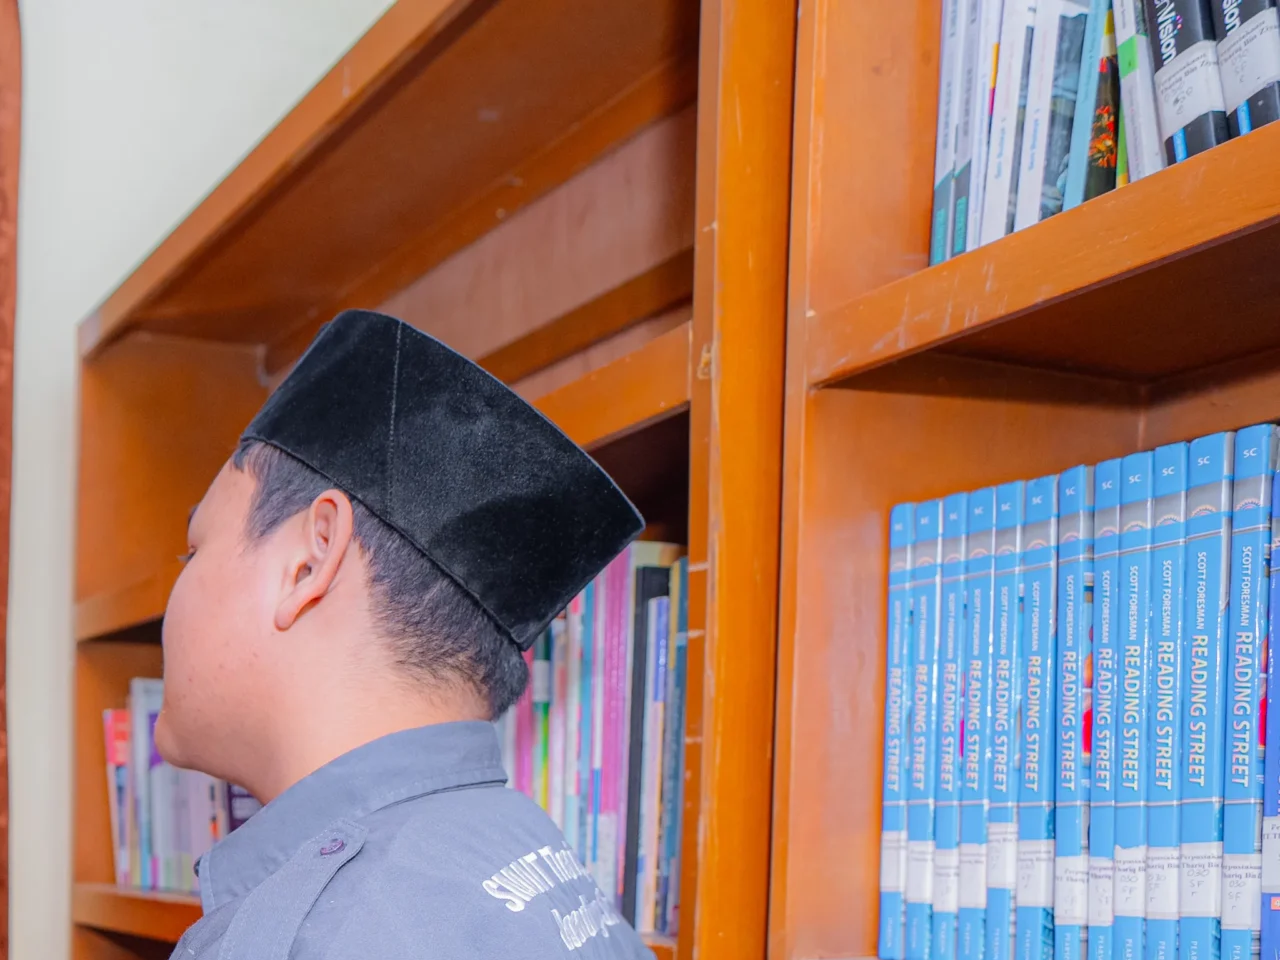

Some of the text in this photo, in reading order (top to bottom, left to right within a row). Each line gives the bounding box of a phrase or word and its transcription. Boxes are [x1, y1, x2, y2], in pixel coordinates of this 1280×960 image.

[1128, 474, 1141, 484] SC
[1162, 466, 1175, 476] SC
[1197, 456, 1210, 466] SC
[1243, 447, 1258, 459] SC
[1102, 480, 1113, 490] SC
[942, 663, 956, 732] READING
[967, 659, 982, 731] READING
[995, 659, 1010, 731] READING
[1026, 655, 1041, 729] READING
[1062, 651, 1077, 727] READING
[1096, 648, 1113, 725] READING
[1122, 565, 1141, 791] SCOTT FORESMAN READING STREET
[1155, 560, 1174, 790] SCOTT FORESMAN READING STREET
[1188, 551, 1209, 787] SCOTT FORESMAN READING STREET
[1231, 546, 1253, 788] SCOTT FORESMAN READING STREET
[941, 736, 954, 792] STREET
[966, 734, 980, 791] STREET
[994, 735, 1008, 793] STREET
[1025, 733, 1040, 792] STREET
[1061, 731, 1075, 791] STREET
[1096, 729, 1110, 791] STREET
